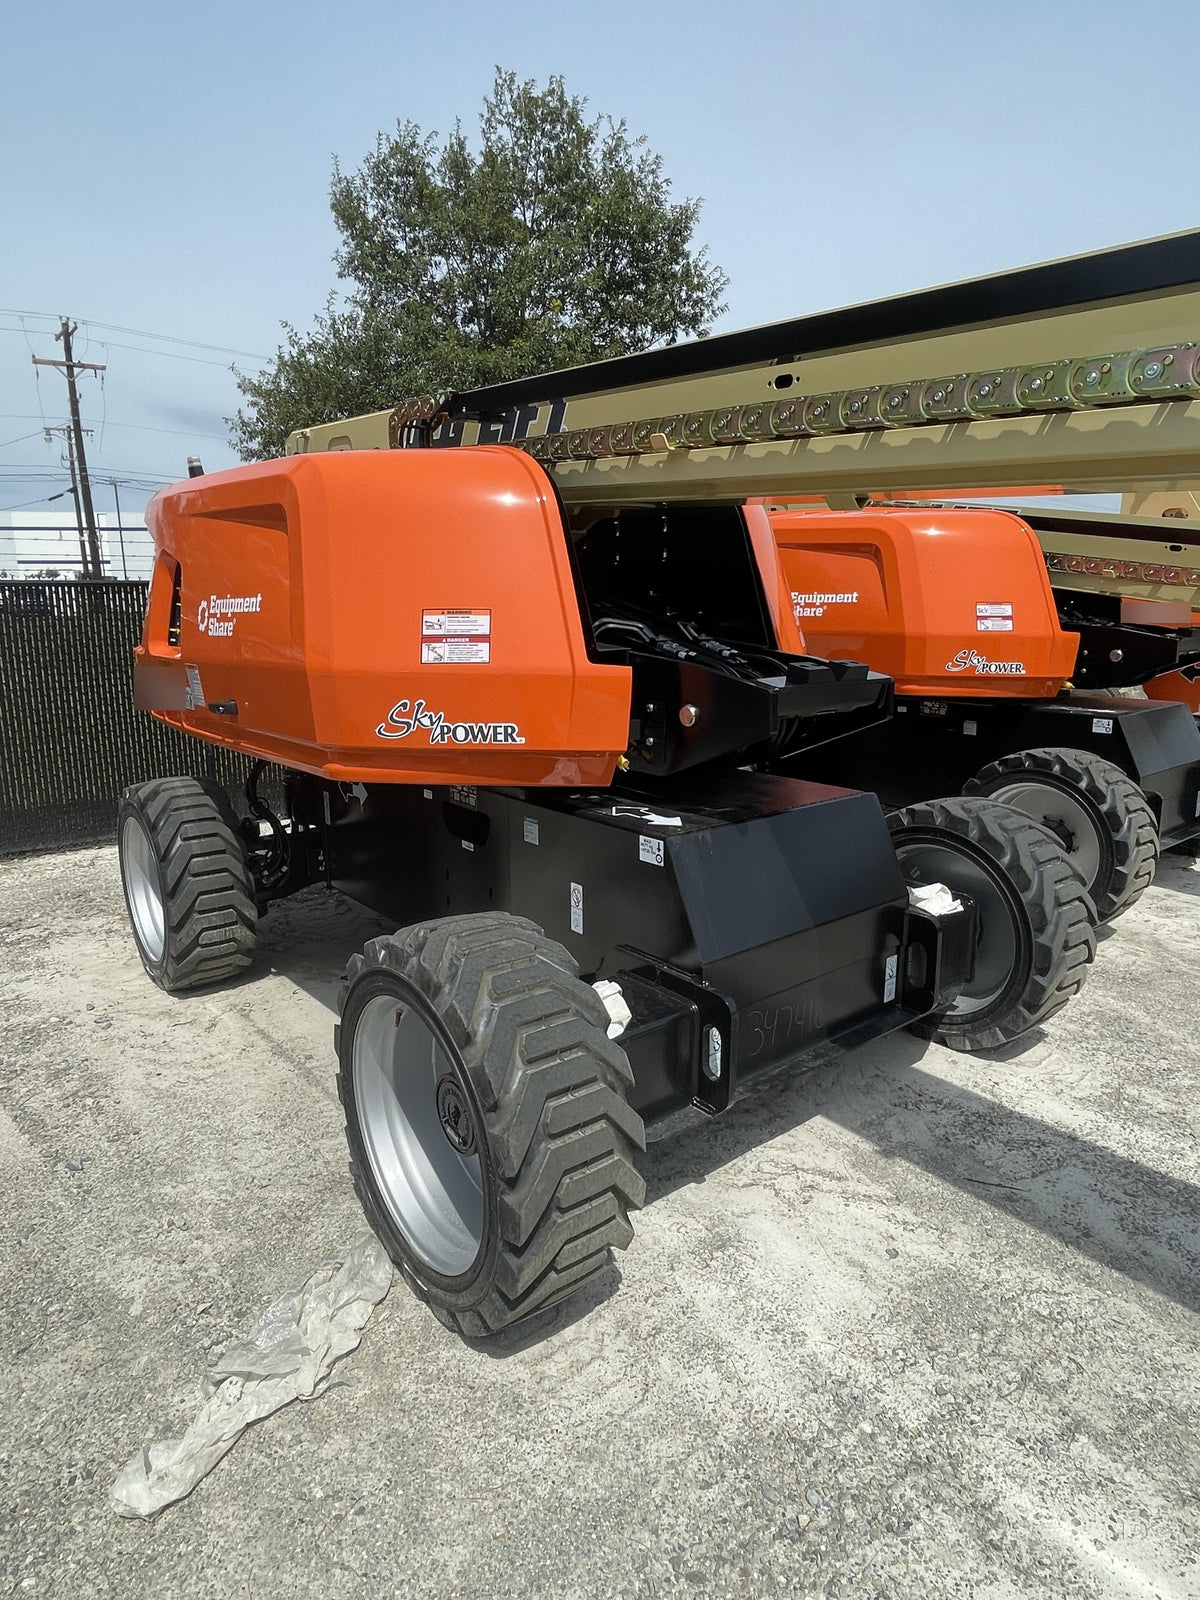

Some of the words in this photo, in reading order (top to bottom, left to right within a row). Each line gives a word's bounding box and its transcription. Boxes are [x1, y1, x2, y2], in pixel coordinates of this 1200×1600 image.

[209, 593, 262, 617] Equipment
[791, 591, 859, 605] Equipment
[793, 605, 823, 616] hare
[208, 617, 234, 636] Share
